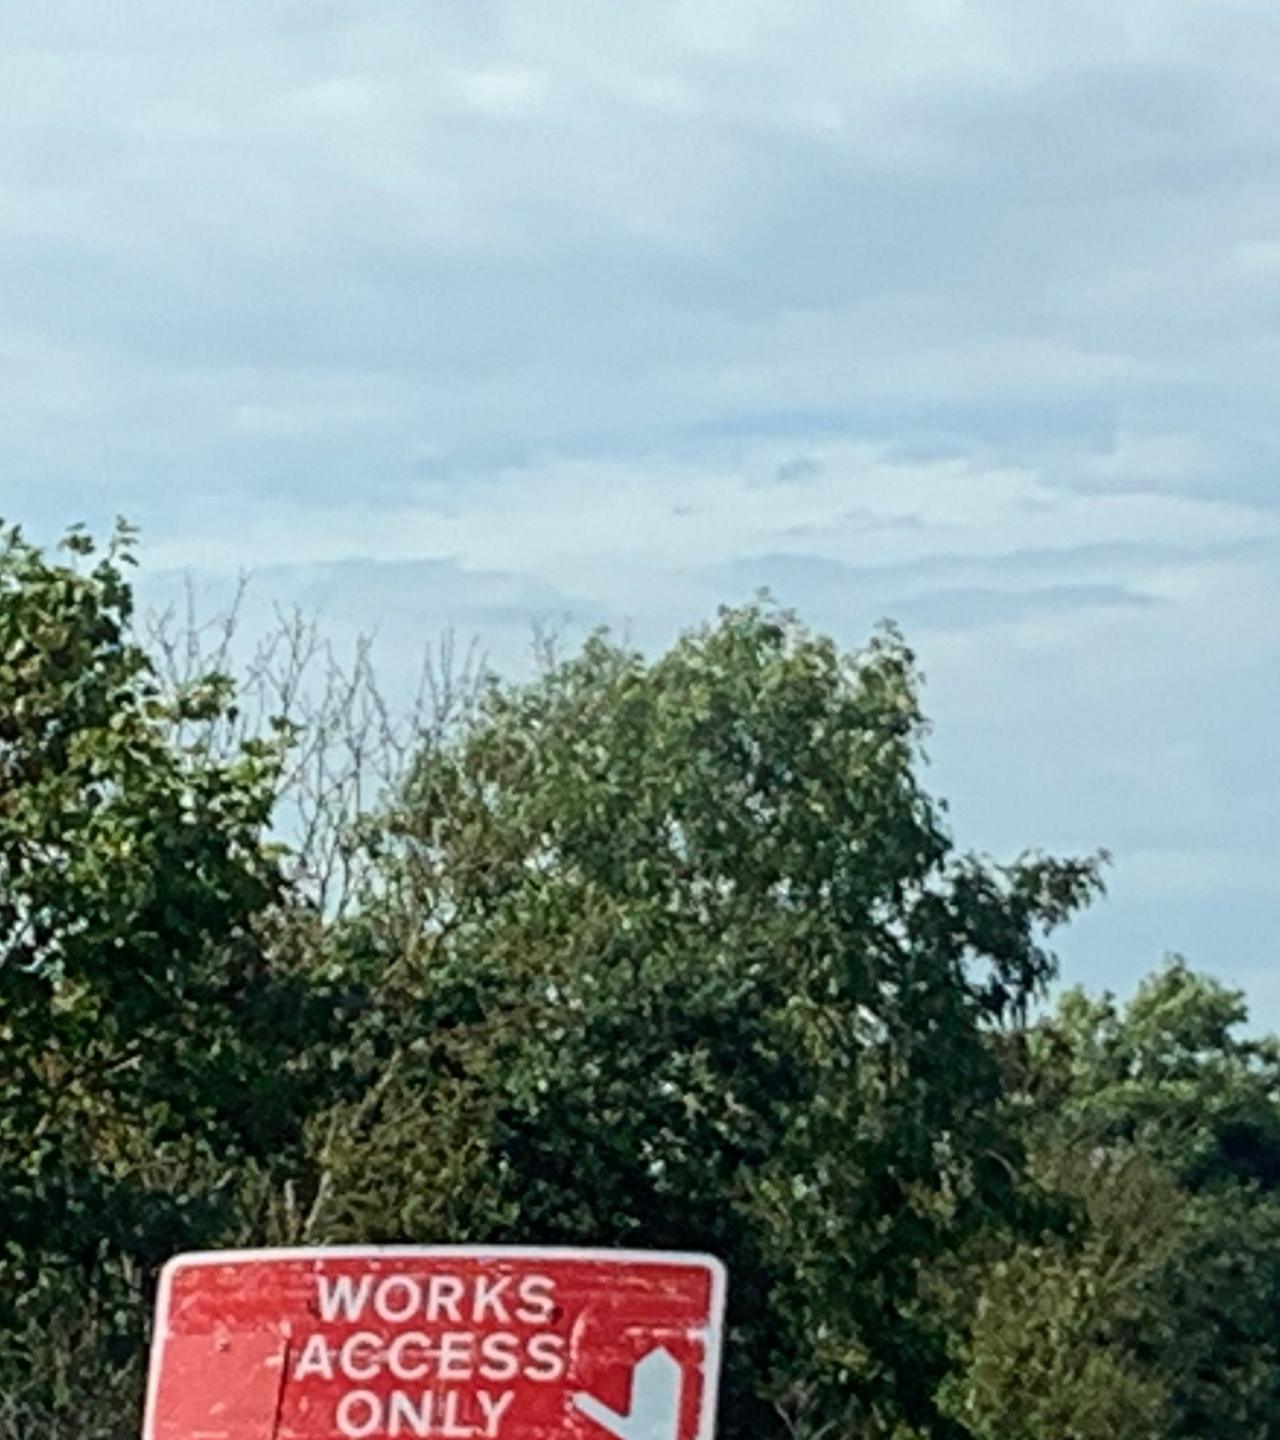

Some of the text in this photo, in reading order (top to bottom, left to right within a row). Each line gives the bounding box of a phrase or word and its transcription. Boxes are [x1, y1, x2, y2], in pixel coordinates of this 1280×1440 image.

[316, 1274, 556, 1325] WORKS
[293, 1333, 565, 1381] ACCESS
[336, 1389, 515, 1438] ONLY
